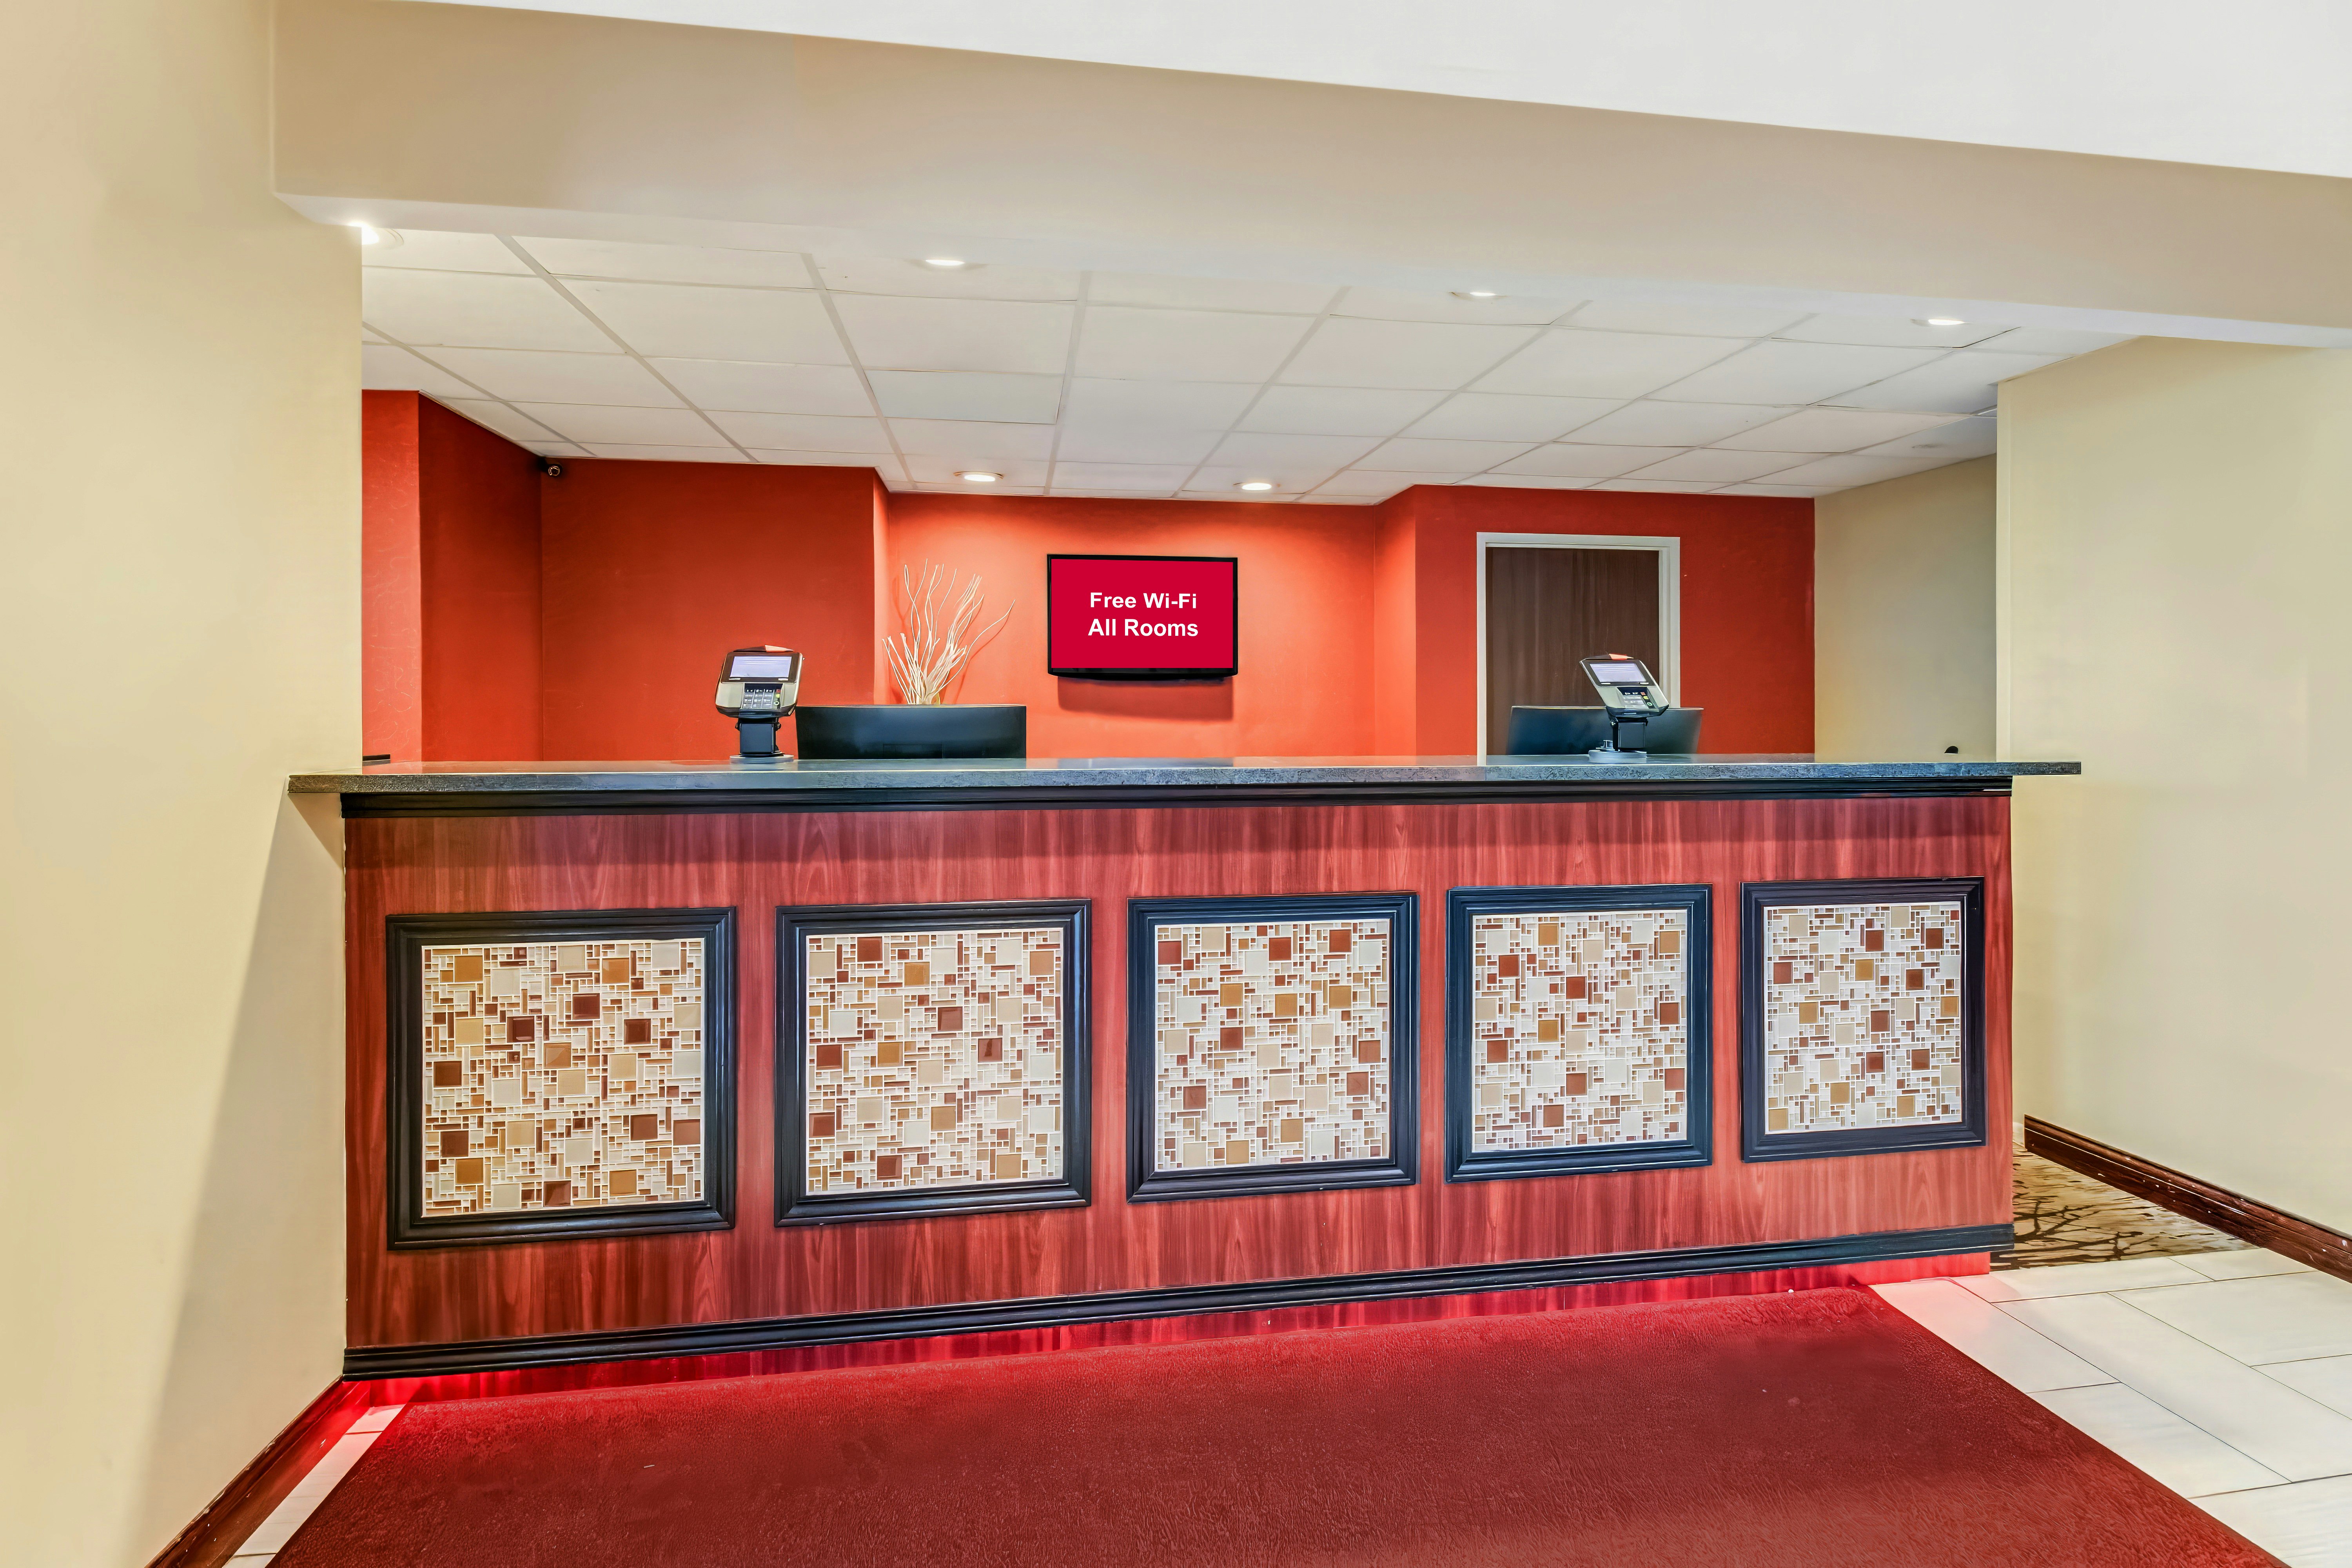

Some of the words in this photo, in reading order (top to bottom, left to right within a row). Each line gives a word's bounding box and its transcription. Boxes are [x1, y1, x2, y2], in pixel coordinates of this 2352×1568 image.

[1091, 592, 1136, 608] Free
[1143, 593, 1196, 608] Wi-Fi
[1088, 619, 1116, 636] All
[1125, 619, 1198, 637] Rooms
